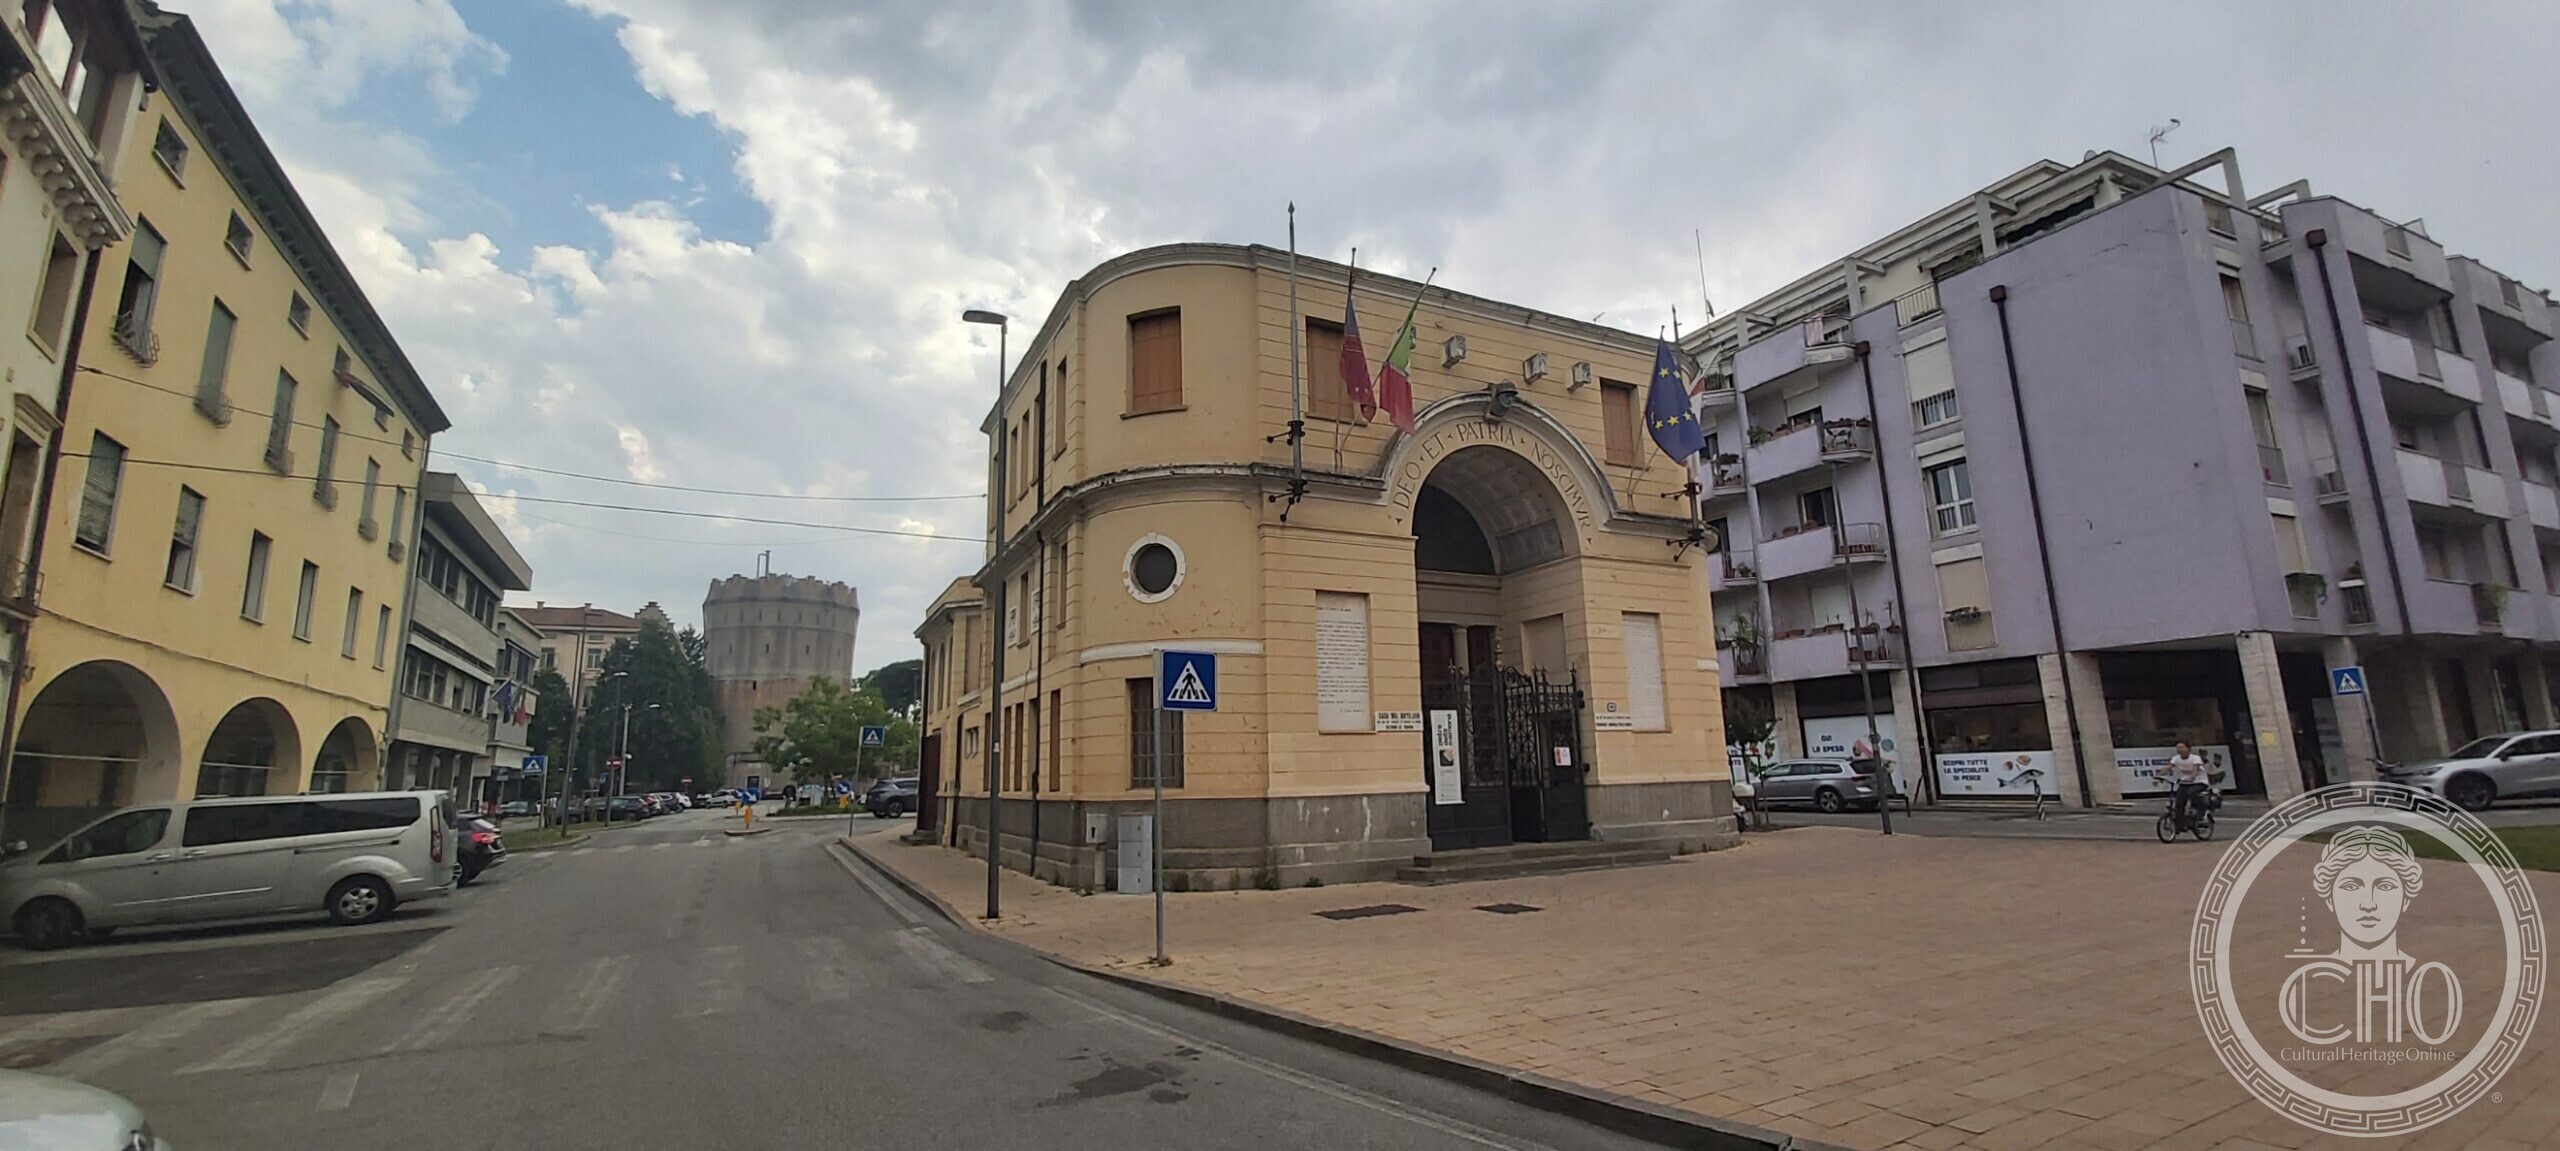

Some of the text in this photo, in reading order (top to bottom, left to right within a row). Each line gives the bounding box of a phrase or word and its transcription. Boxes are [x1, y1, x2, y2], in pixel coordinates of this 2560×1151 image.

[1392, 461, 1421, 510] DEO
[1421, 430, 1445, 460] ET
[1455, 421, 1516, 447] PATRIA
[1822, 745, 1845, 753] SPESA
